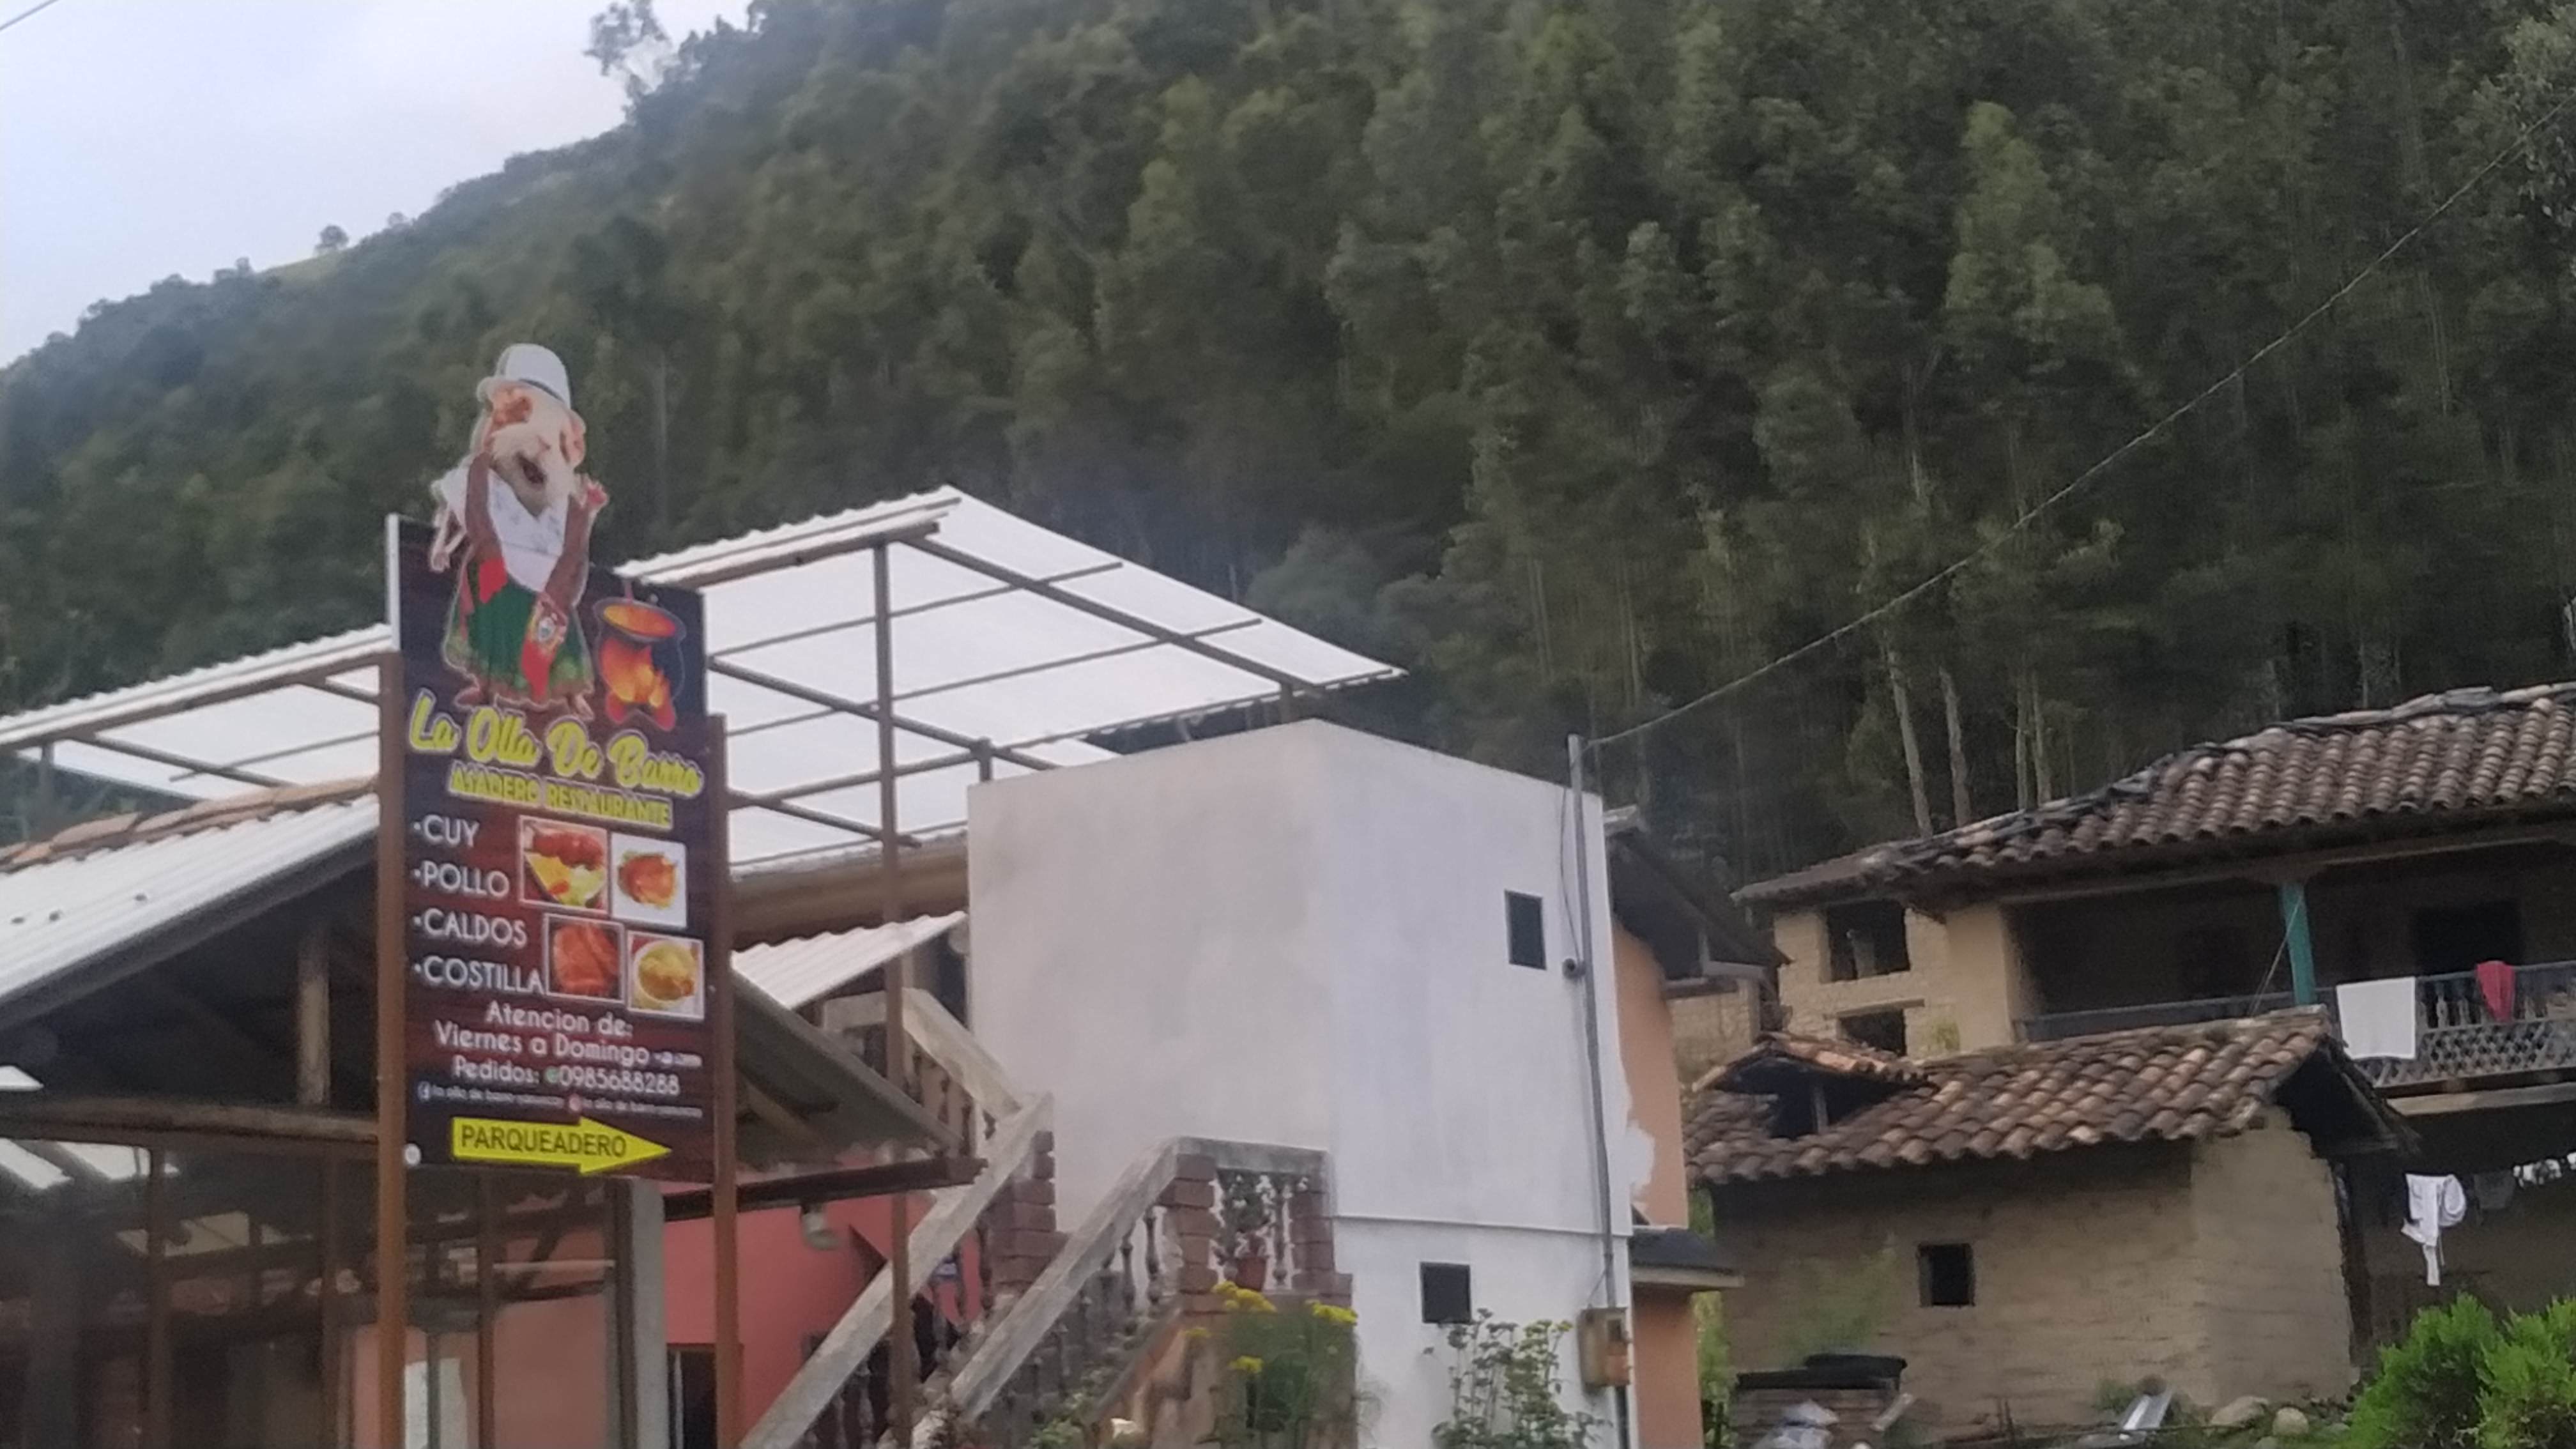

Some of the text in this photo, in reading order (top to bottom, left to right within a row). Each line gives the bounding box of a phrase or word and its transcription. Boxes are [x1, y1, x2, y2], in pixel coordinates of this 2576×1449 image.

[410, 693, 459, 750] La
[467, 707, 539, 763] Olla
[546, 718, 602, 777] De
[451, 768, 671, 825] ASADERO RESTAURANTE
[486, 1000, 590, 1033] Atencion
[434, 1020, 523, 1054] Viernes
[530, 1037, 548, 1055] a
[555, 1032, 650, 1068] Domingo
[453, 1055, 680, 1096] Pedidos: 0985688288
[461, 1125, 627, 1158] PARQUEADERO
